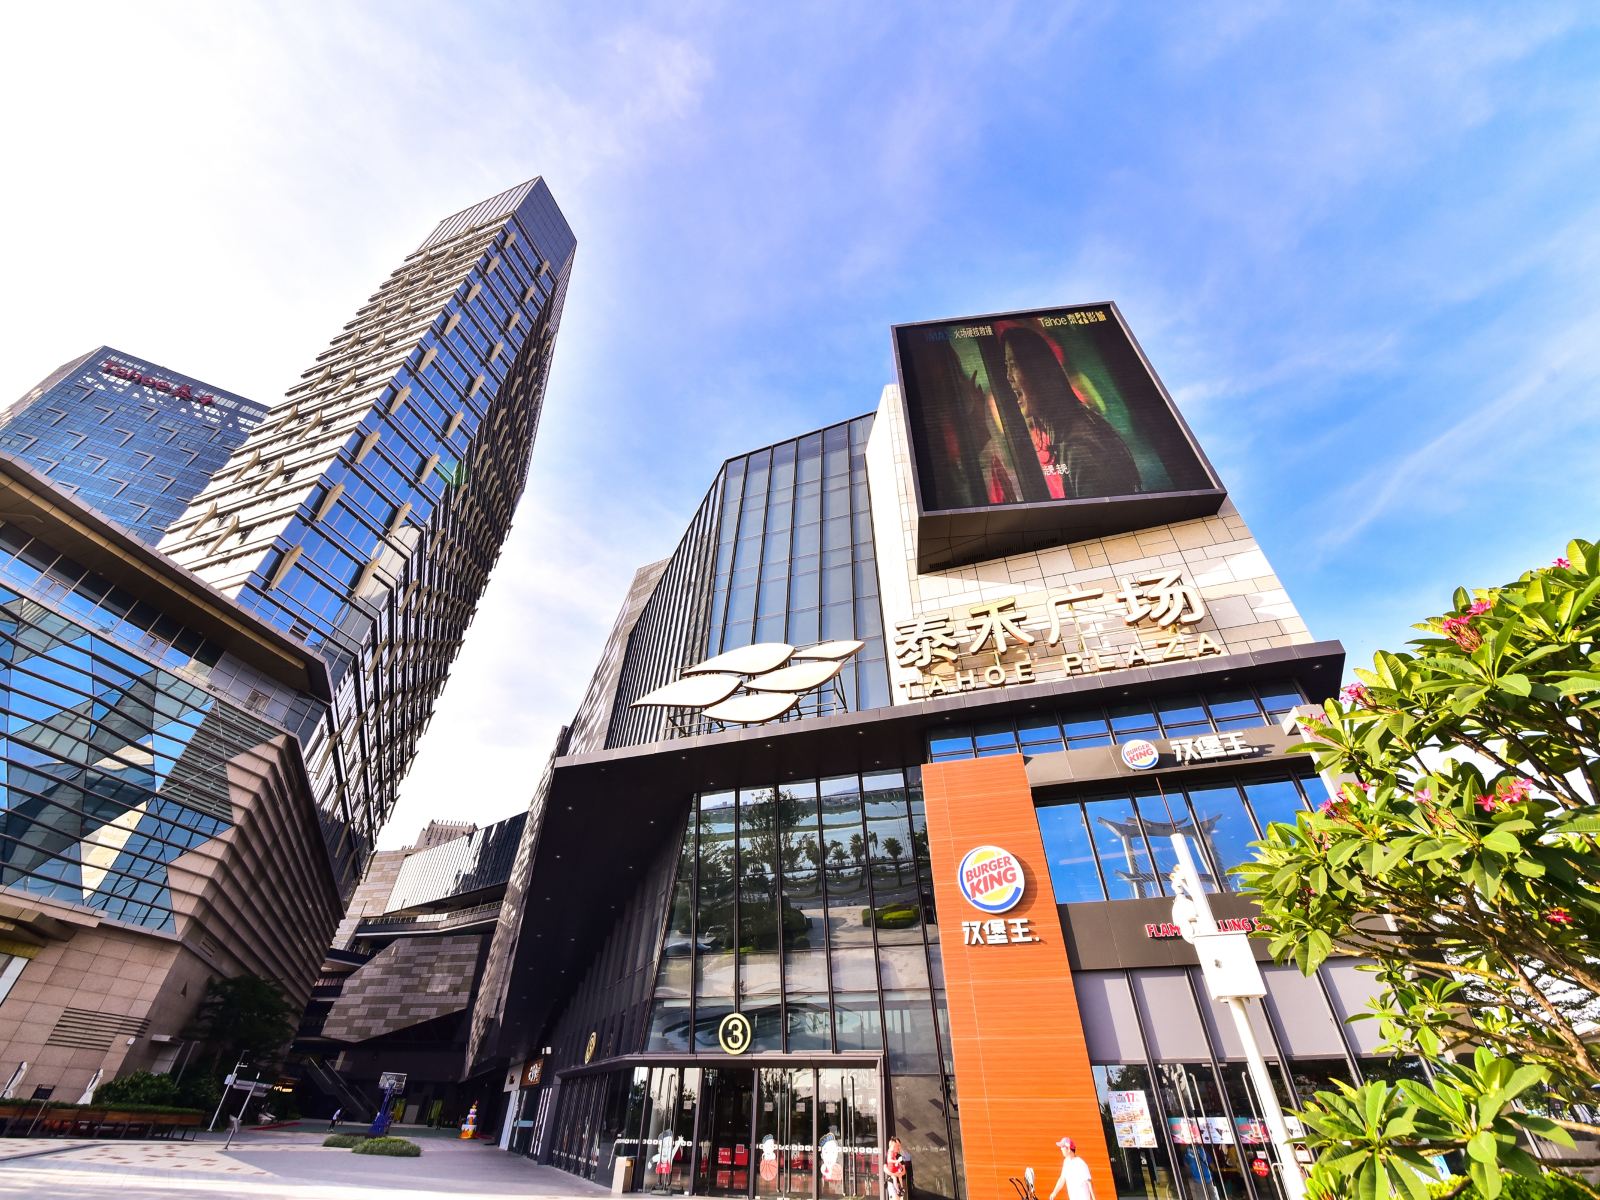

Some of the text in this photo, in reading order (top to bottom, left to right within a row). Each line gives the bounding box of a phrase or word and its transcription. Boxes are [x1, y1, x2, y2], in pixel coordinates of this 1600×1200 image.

[1037, 317, 1068, 328] Tahoe
[895, 568, 1206, 668] 泰禾广场
[899, 632, 1222, 700] TAHOE PLAZA
[1126, 742, 1151, 757] BURGER
[1128, 748, 1155, 764] KING
[965, 856, 1013, 883] BURGER
[968, 866, 1017, 899] KING
[1145, 922, 1183, 938] FLAM
[1125, 1092, 1135, 1103] 17
